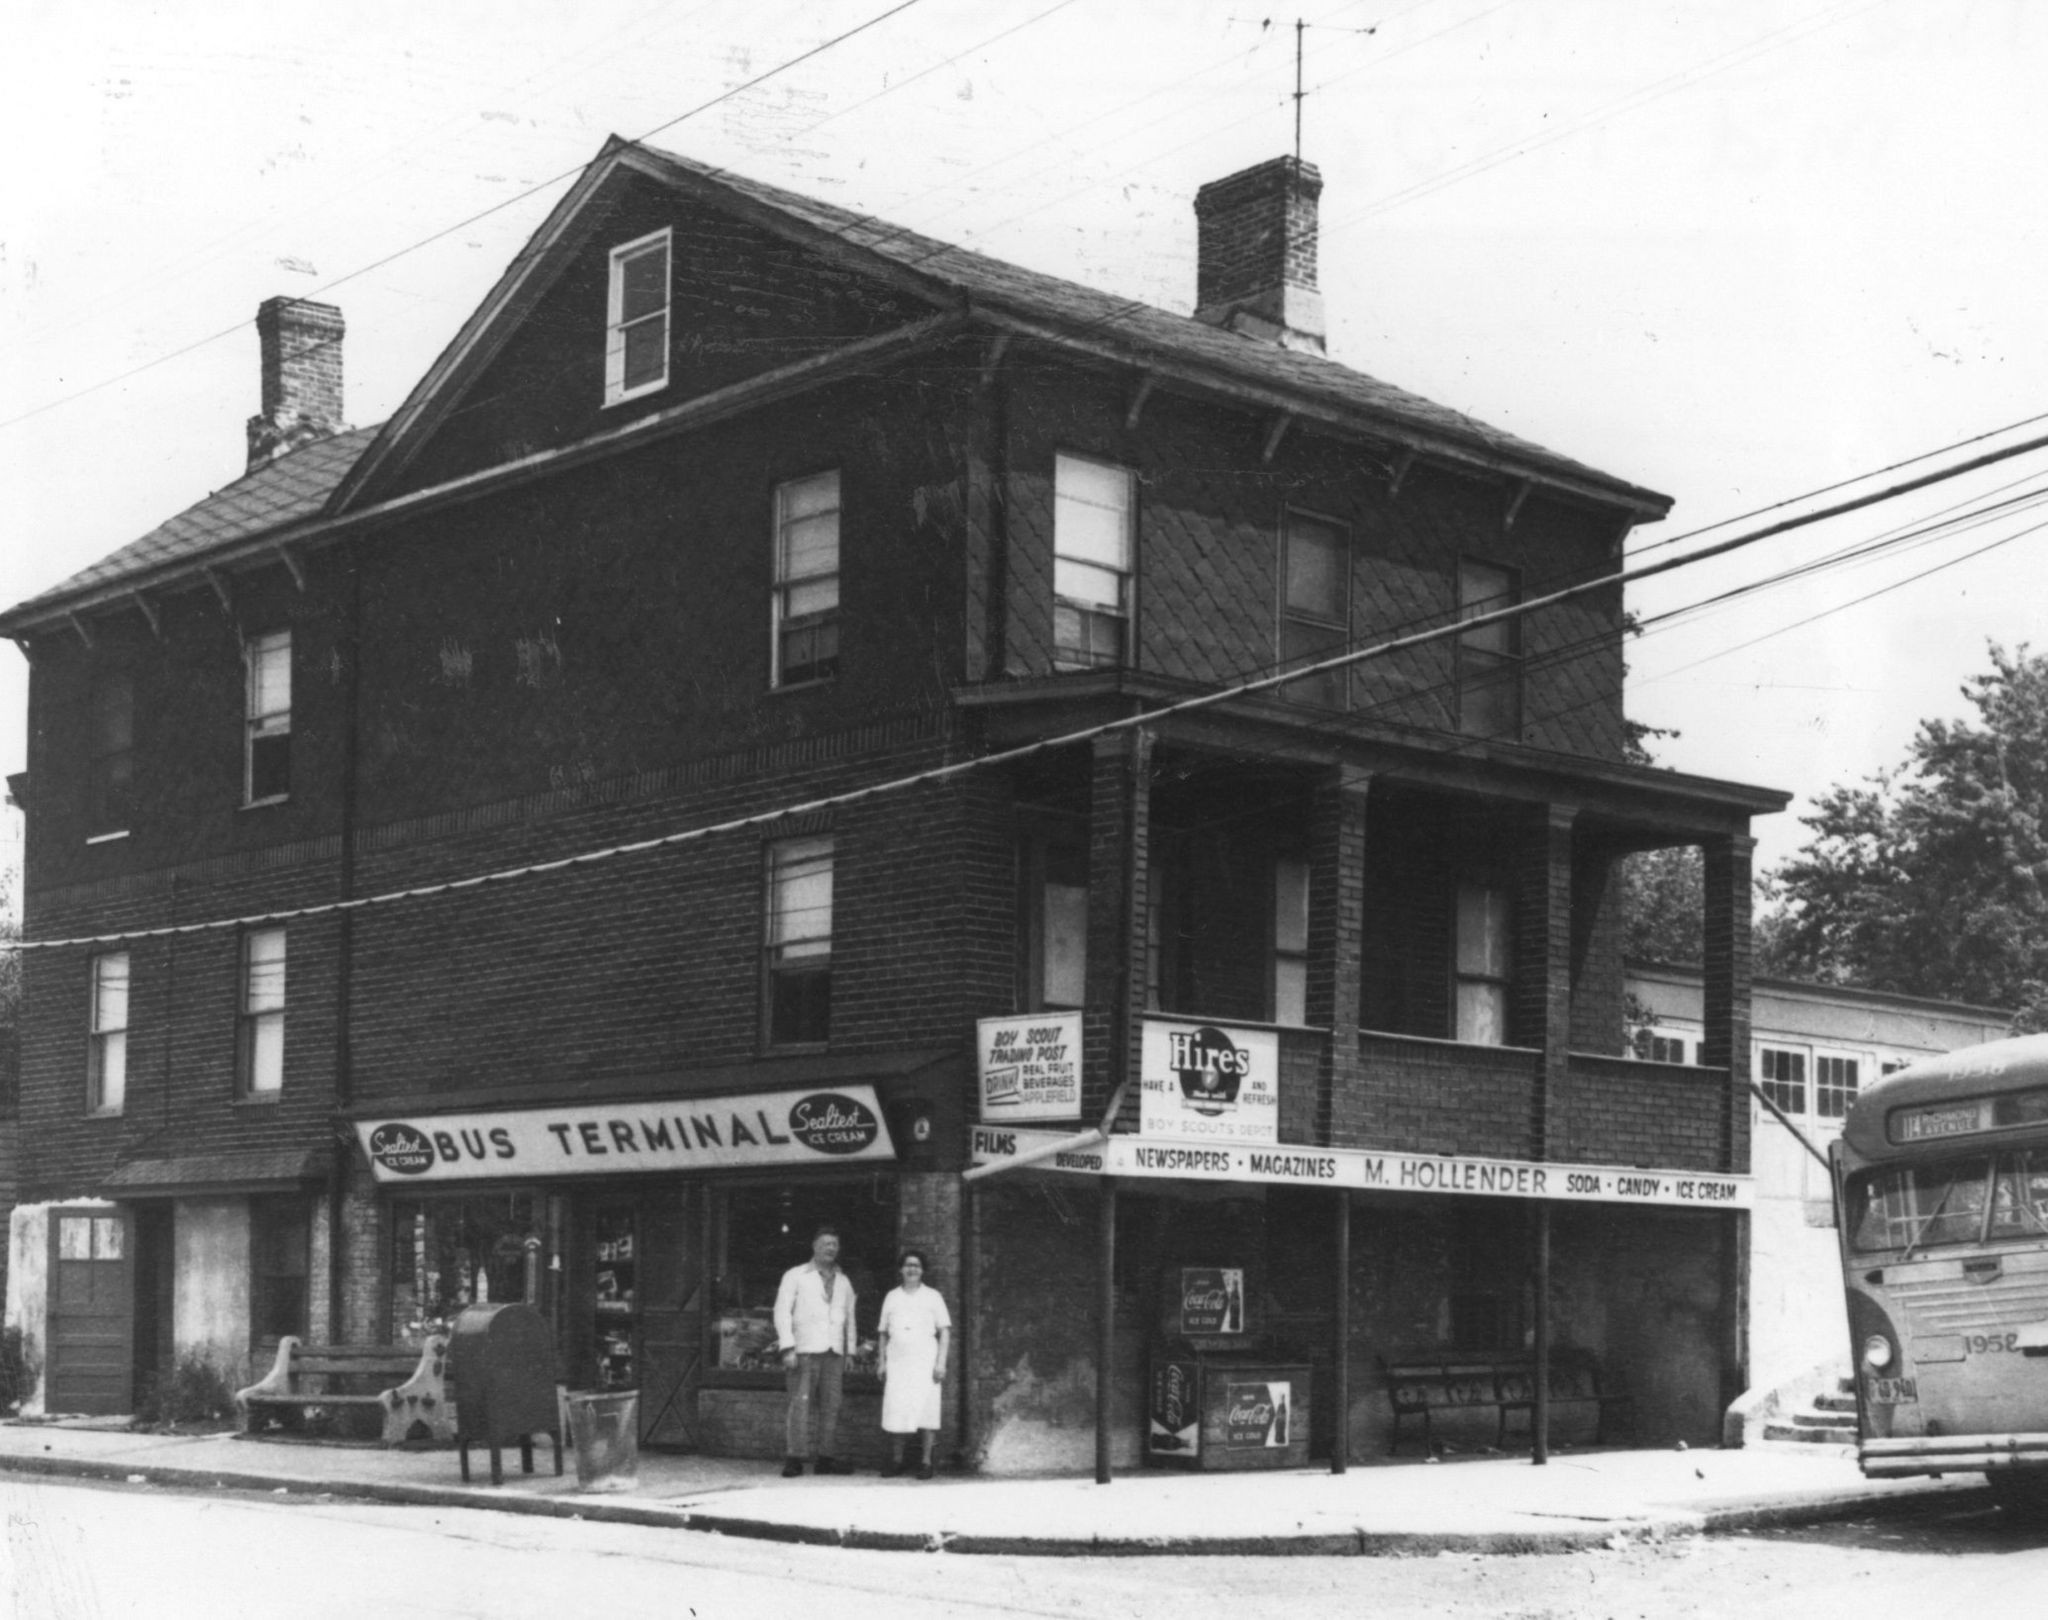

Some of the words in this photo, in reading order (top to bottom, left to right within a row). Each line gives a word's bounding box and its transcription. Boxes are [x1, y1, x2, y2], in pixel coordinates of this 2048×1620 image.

[994, 1030, 1019, 1047] BOY
[1026, 1026, 1063, 1044] SCOUT
[1036, 1045, 1068, 1061] POST
[1170, 1032, 1249, 1077] Hires
[792, 1102, 875, 1131] Sealtest
[1182, 1120, 1235, 1134] SCOUTS
[433, 1128, 515, 1162] BUS
[547, 1110, 791, 1156] TERMINAL
[808, 1132, 825, 1144] ICE
[827, 1131, 866, 1144] CREAM
[975, 1131, 1016, 1155] FILMS
[1056, 1152, 1103, 1170] DEVELOPED
[1136, 1148, 1230, 1171] NEWSPAPERS
[1250, 1154, 1336, 1178] MAGAZINES
[1365, 1158, 1389, 1185] M.
[1401, 1160, 1547, 1193] HOLLENDER
[1566, 1174, 1601, 1193] SODA
[1617, 1177, 1660, 1196] CANDY
[1676, 1181, 1695, 1199] ICE
[1698, 1182, 1737, 1200] CREAM
[1229, 1403, 1272, 1426] Coca-Cola
